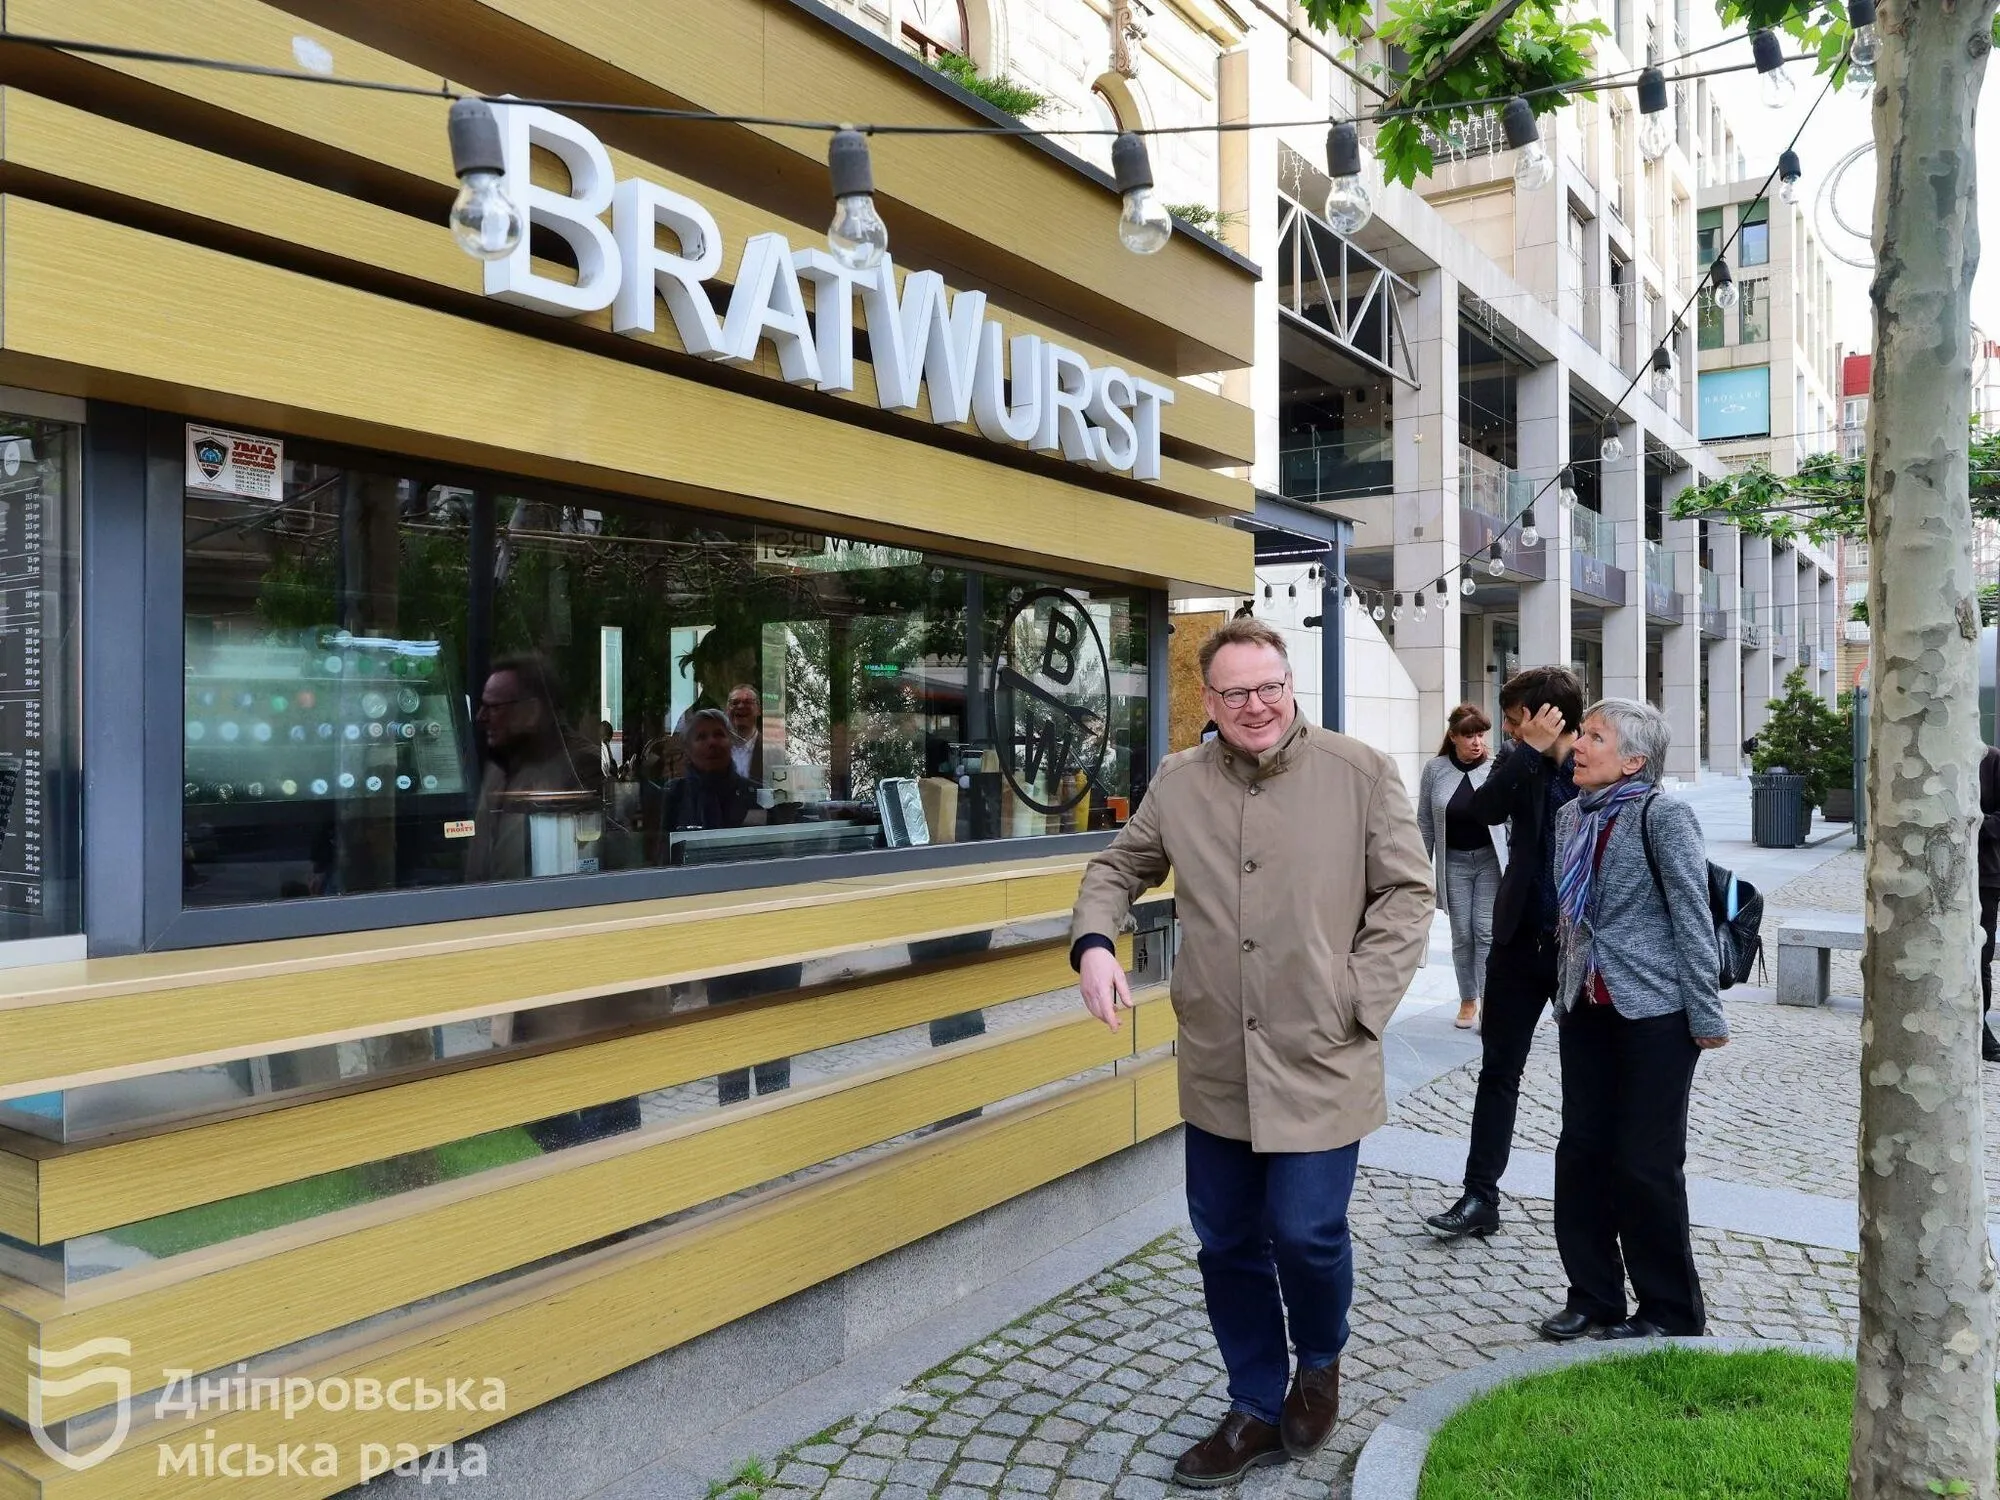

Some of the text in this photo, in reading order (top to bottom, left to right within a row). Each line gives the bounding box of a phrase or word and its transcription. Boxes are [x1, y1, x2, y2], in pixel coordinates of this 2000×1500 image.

[483, 94, 1174, 481] BRATWURST
[232, 441, 277, 459] УВАГА,
[1042, 607, 1077, 685] B
